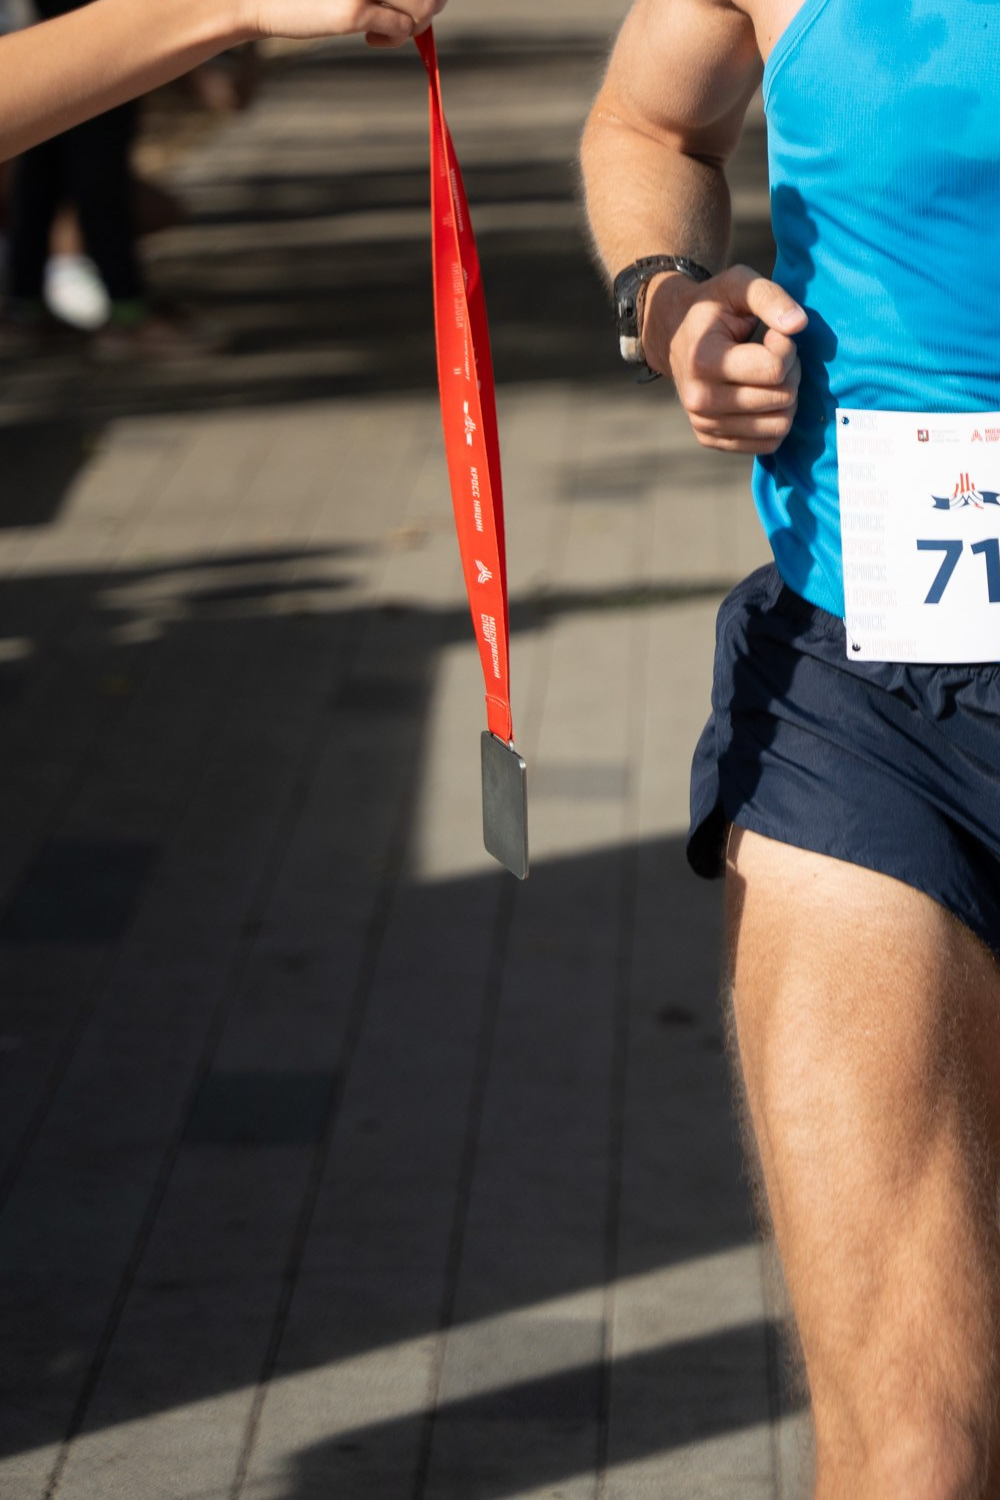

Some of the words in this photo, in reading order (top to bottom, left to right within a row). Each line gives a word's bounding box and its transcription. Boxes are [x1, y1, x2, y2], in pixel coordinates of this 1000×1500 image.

[470, 467, 481, 498] КРОСС
[473, 499, 484, 532] НАЦИИ
[481, 614, 490, 643] СПОРТ
[488, 615, 501, 679] МОСКОВСКИЙ
